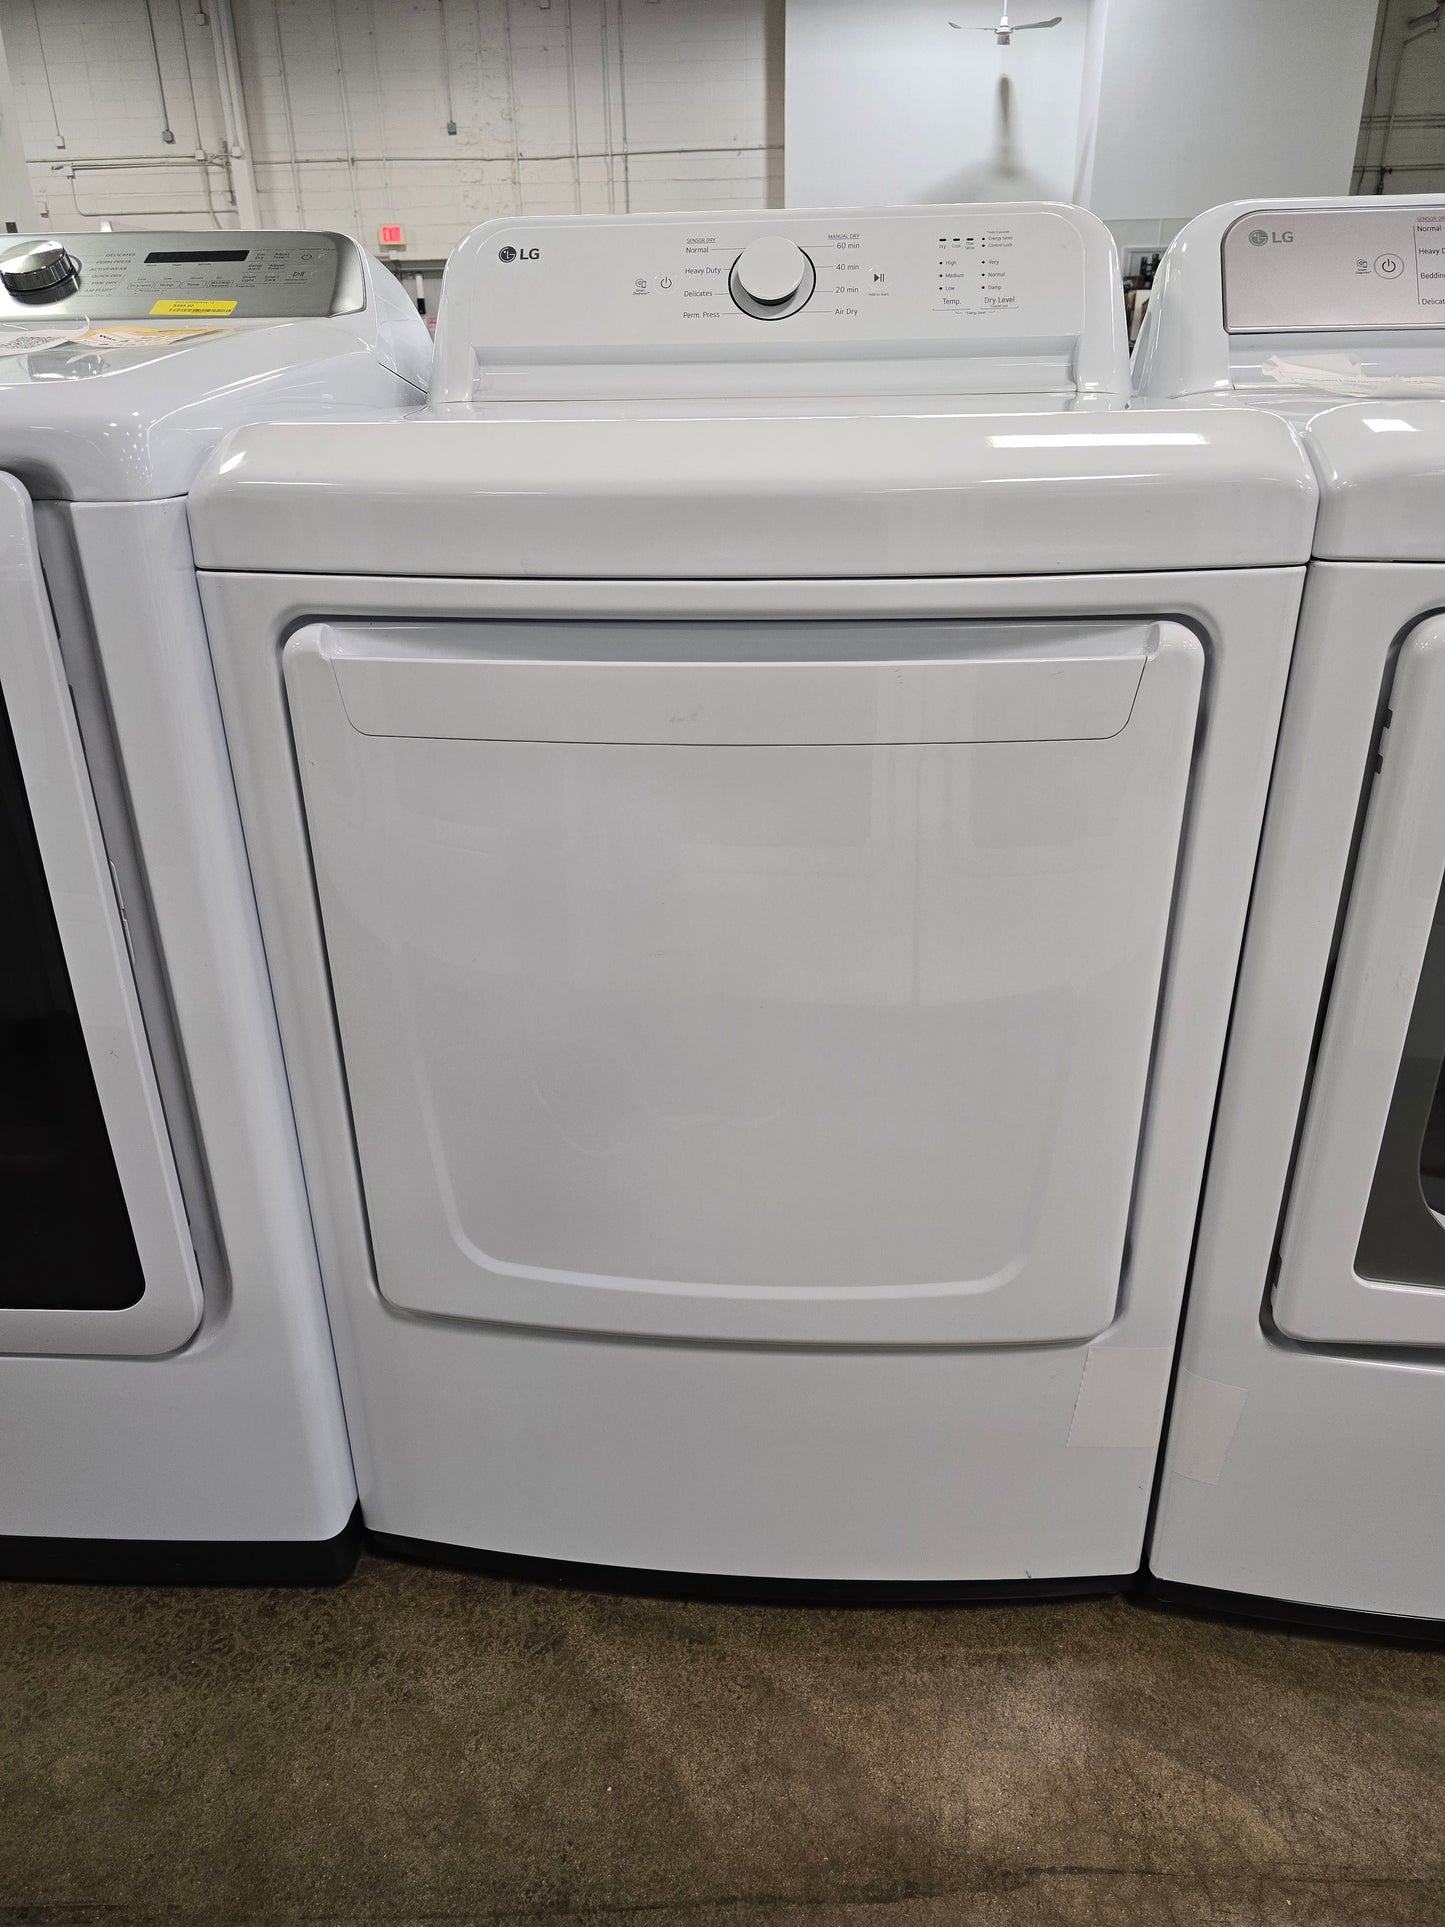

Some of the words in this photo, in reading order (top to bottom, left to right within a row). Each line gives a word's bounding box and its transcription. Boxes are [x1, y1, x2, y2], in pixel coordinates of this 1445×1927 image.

[1272, 232, 1294, 243] LG
[520, 248, 540, 260] LG
[685, 267, 704, 275] Heavy
[846, 308, 858, 316] Dry
